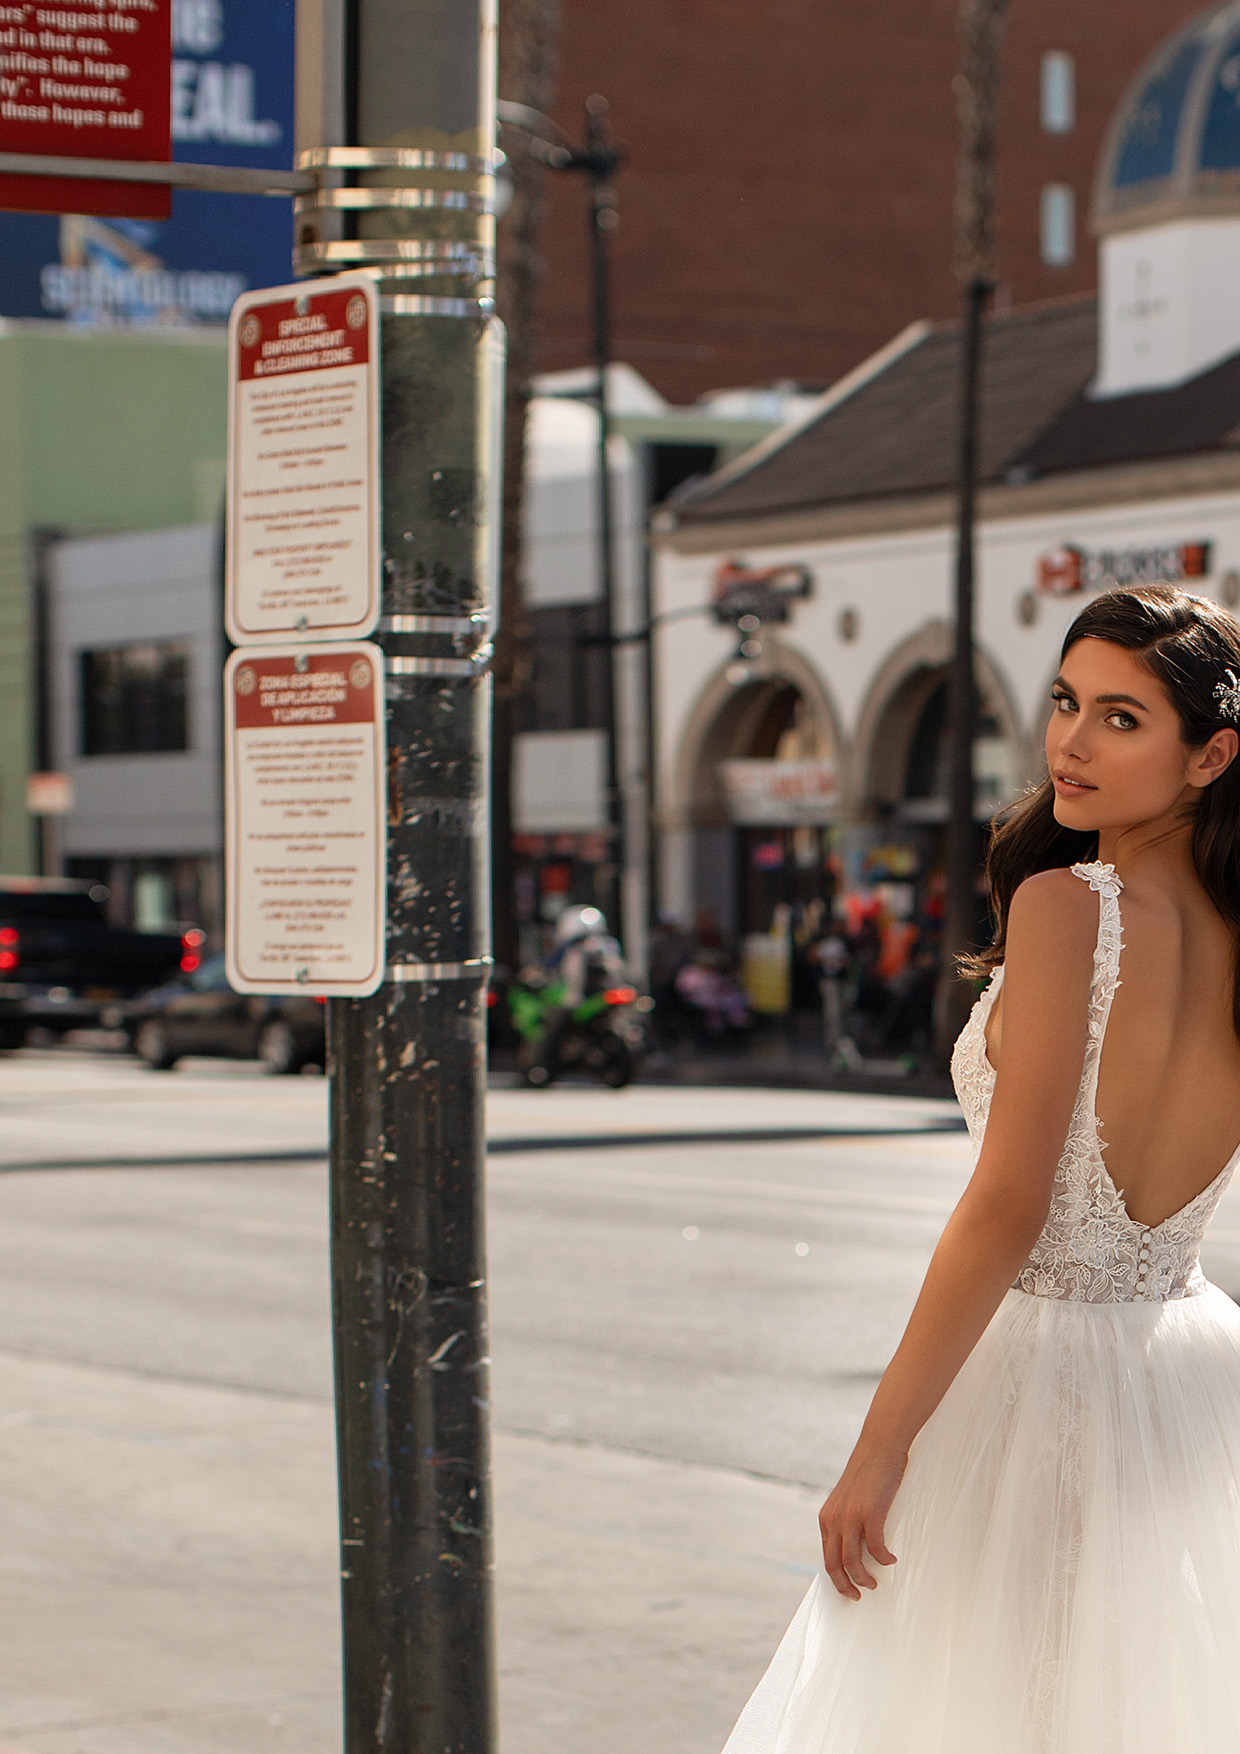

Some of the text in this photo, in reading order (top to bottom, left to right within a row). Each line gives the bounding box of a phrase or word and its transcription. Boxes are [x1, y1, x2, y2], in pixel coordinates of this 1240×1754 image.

[36, 9, 106, 32] suggest
[107, 11, 139, 33] the
[38, 29, 75, 52] that
[52, 55, 82, 77] the
[84, 56, 130, 83] hope
[40, 77, 126, 106] However,
[52, 102, 106, 129] hopes
[107, 108, 143, 129] and
[278, 314, 328, 337] SPECIAL
[262, 329, 346, 359] ENFORCEMENT
